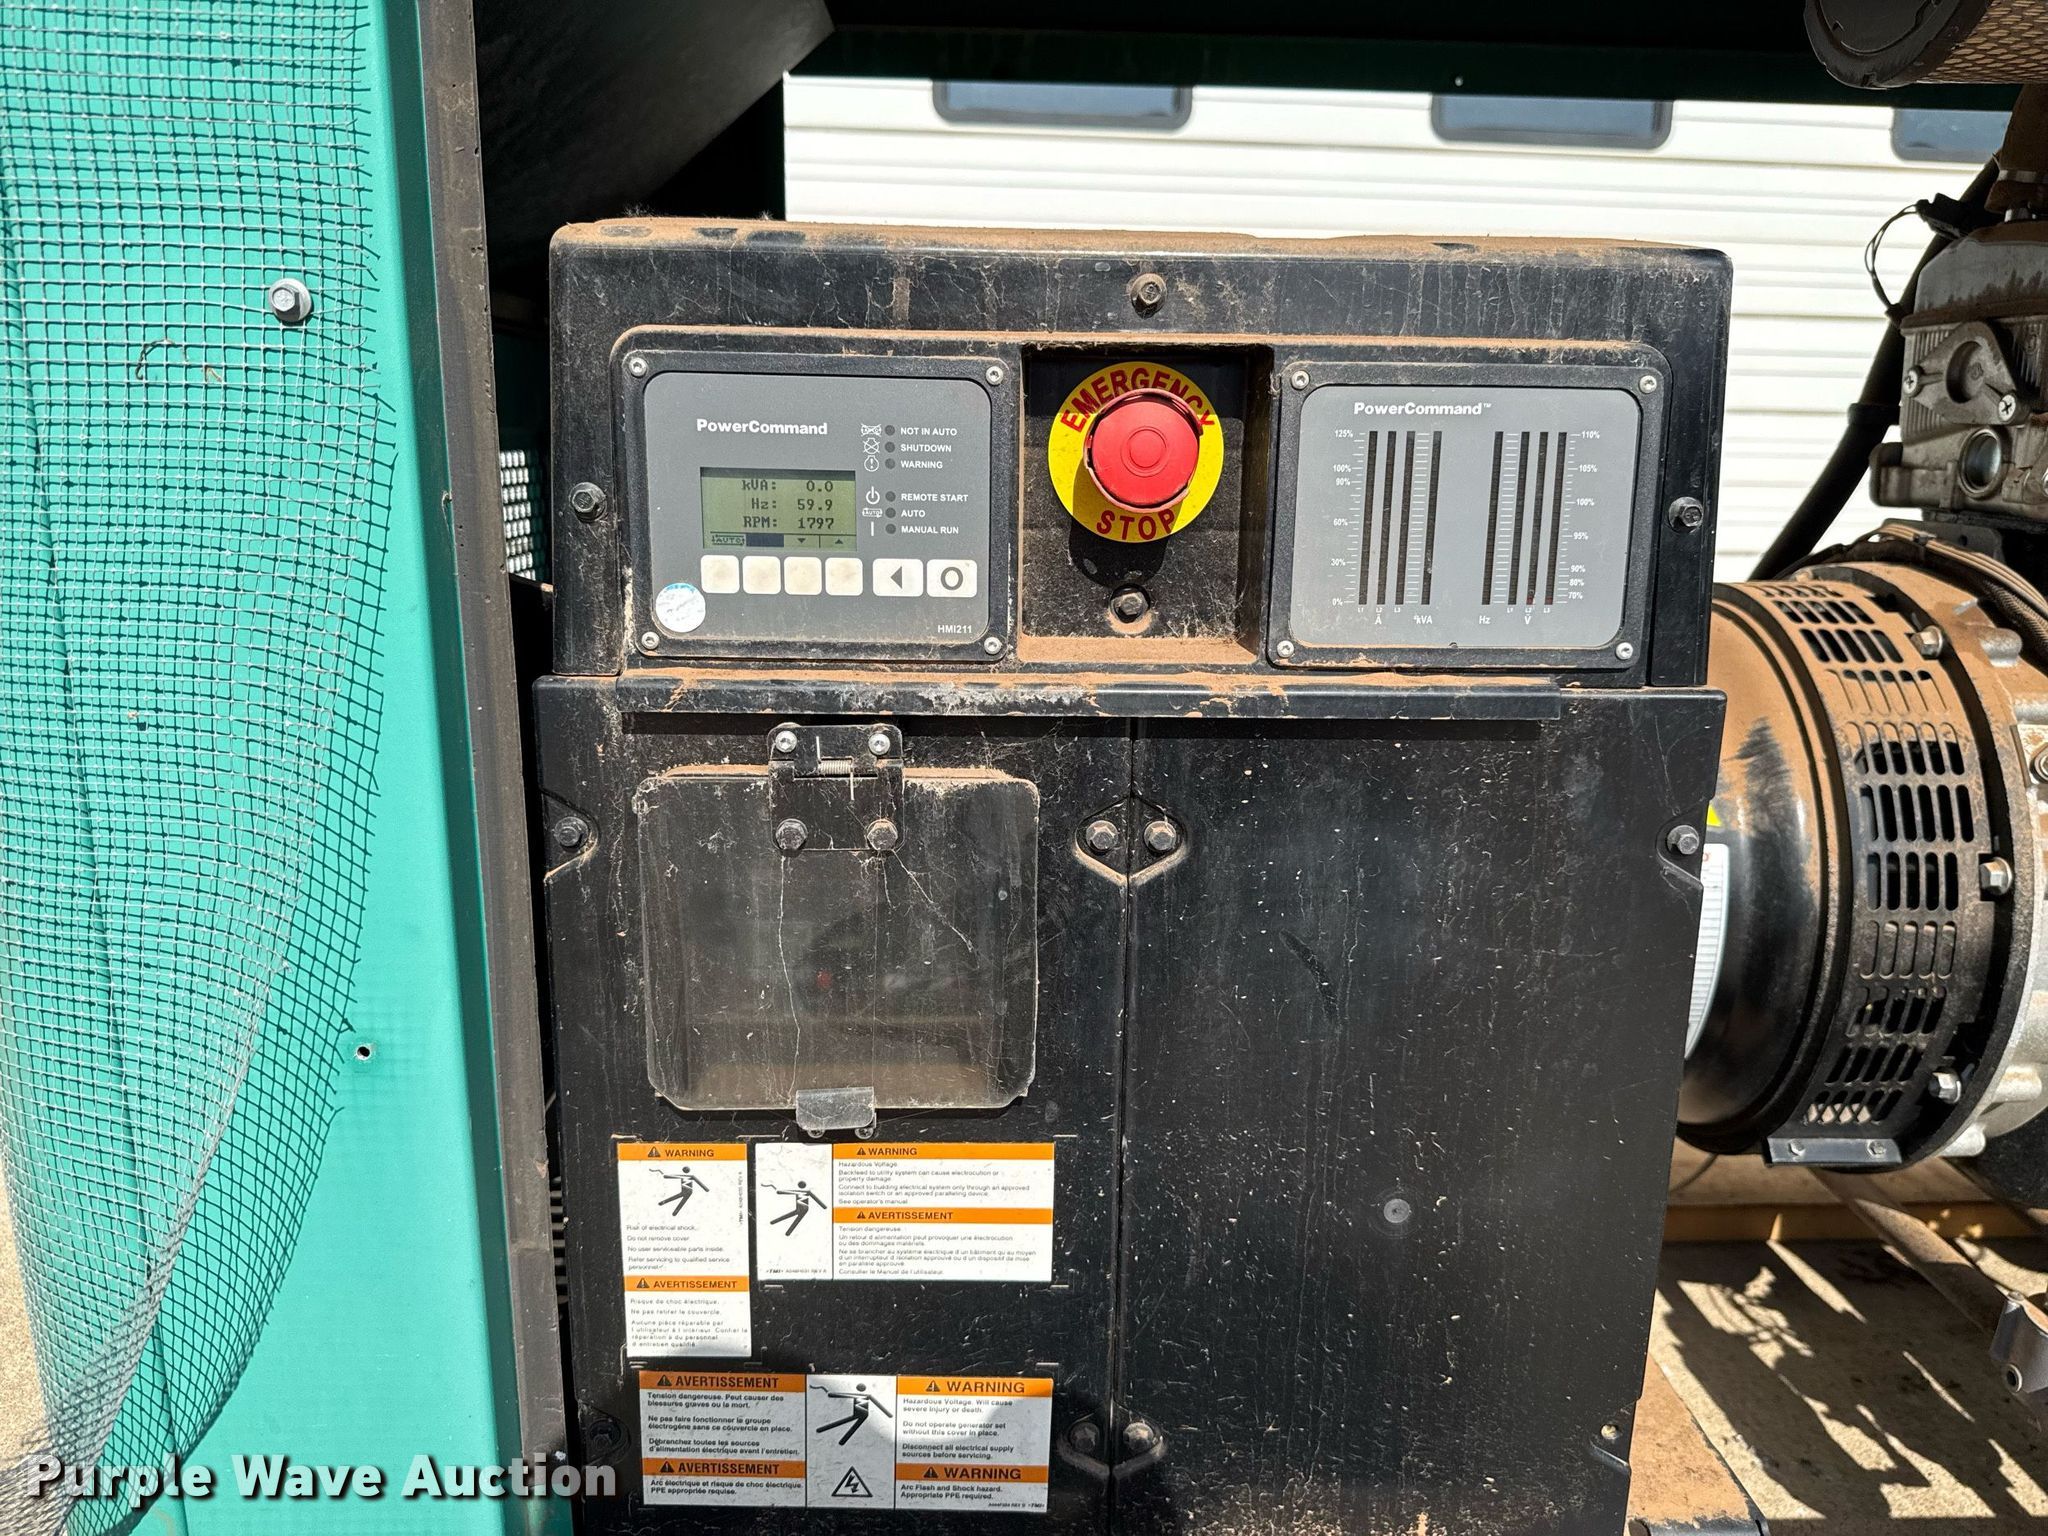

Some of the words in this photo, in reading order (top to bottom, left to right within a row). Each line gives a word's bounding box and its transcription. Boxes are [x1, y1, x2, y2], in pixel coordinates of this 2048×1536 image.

[1060, 368, 1216, 432] EMERGENCY
[697, 419, 828, 435] PowerCommand
[900, 427, 919, 435] NOT
[921, 427, 930, 435] IN
[932, 428, 957, 436] AUTO
[1334, 430, 1353, 439] 125%
[1581, 430, 1600, 439] 110%
[900, 444, 952, 452] SHUTDOWN
[901, 460, 943, 469] WARNING
[1332, 464, 1352, 473] 100%
[1578, 464, 1598, 473] 105%
[742, 479, 777, 491] kVA:
[806, 480, 834, 492] 0.0
[1335, 477, 1351, 486] 90%
[901, 493, 938, 501] REMOTE
[940, 494, 969, 502] START
[1576, 498, 1595, 506] 100%
[751, 498, 777, 511] Hz:
[797, 499, 833, 511] 59.9
[901, 509, 926, 517] AUTO
[743, 516, 778, 529] RPM:
[797, 517, 834, 530] 1797
[1096, 508, 1176, 541] STOP
[1333, 518, 1349, 527] 60%
[901, 525, 938, 534] MANUAL
[940, 526, 959, 534] RUN
[714, 537, 743, 545] AUTO
[1573, 532, 1589, 541] 95%
[1331, 558, 1346, 567] 30%
[1570, 565, 1586, 573] 90%
[1568, 591, 1583, 599] 70%
[1332, 598, 1343, 606] 0%
[1479, 615, 1491, 625] Hz
[937, 624, 973, 634] HMI211
[664, 1149, 714, 1158] WARNING
[868, 1147, 918, 1156] WARNING
[868, 1211, 954, 1220] AVERTISSEMENT
[653, 1280, 739, 1289] AVERTISSEMENT
[675, 1375, 779, 1388] AVERTISSEMENT
[946, 1381, 1025, 1393] WARNING
[678, 1393, 723, 1402] dangereuse.
[944, 1399, 972, 1407] Voltage.
[928, 1406, 949, 1414] injury
[660, 1416, 674, 1424] pas
[770, 1425, 793, 1433] place.
[929, 1421, 956, 1430] operate
[958, 1422, 993, 1430] generator
[978, 1430, 999, 1438] place.
[989, 1444, 1014, 1453] supply
[958, 1452, 992, 1461] servicing.
[678, 1462, 780, 1475] AVERTISSEMENT
[944, 1467, 1022, 1479] WARNING
[665, 1479, 700, 1488] électrique
[711, 1480, 734, 1489] risque
[765, 1481, 803, 1490] électrique.
[900, 1492, 943, 1500] Appropriate
[962, 1492, 994, 1501] required.
